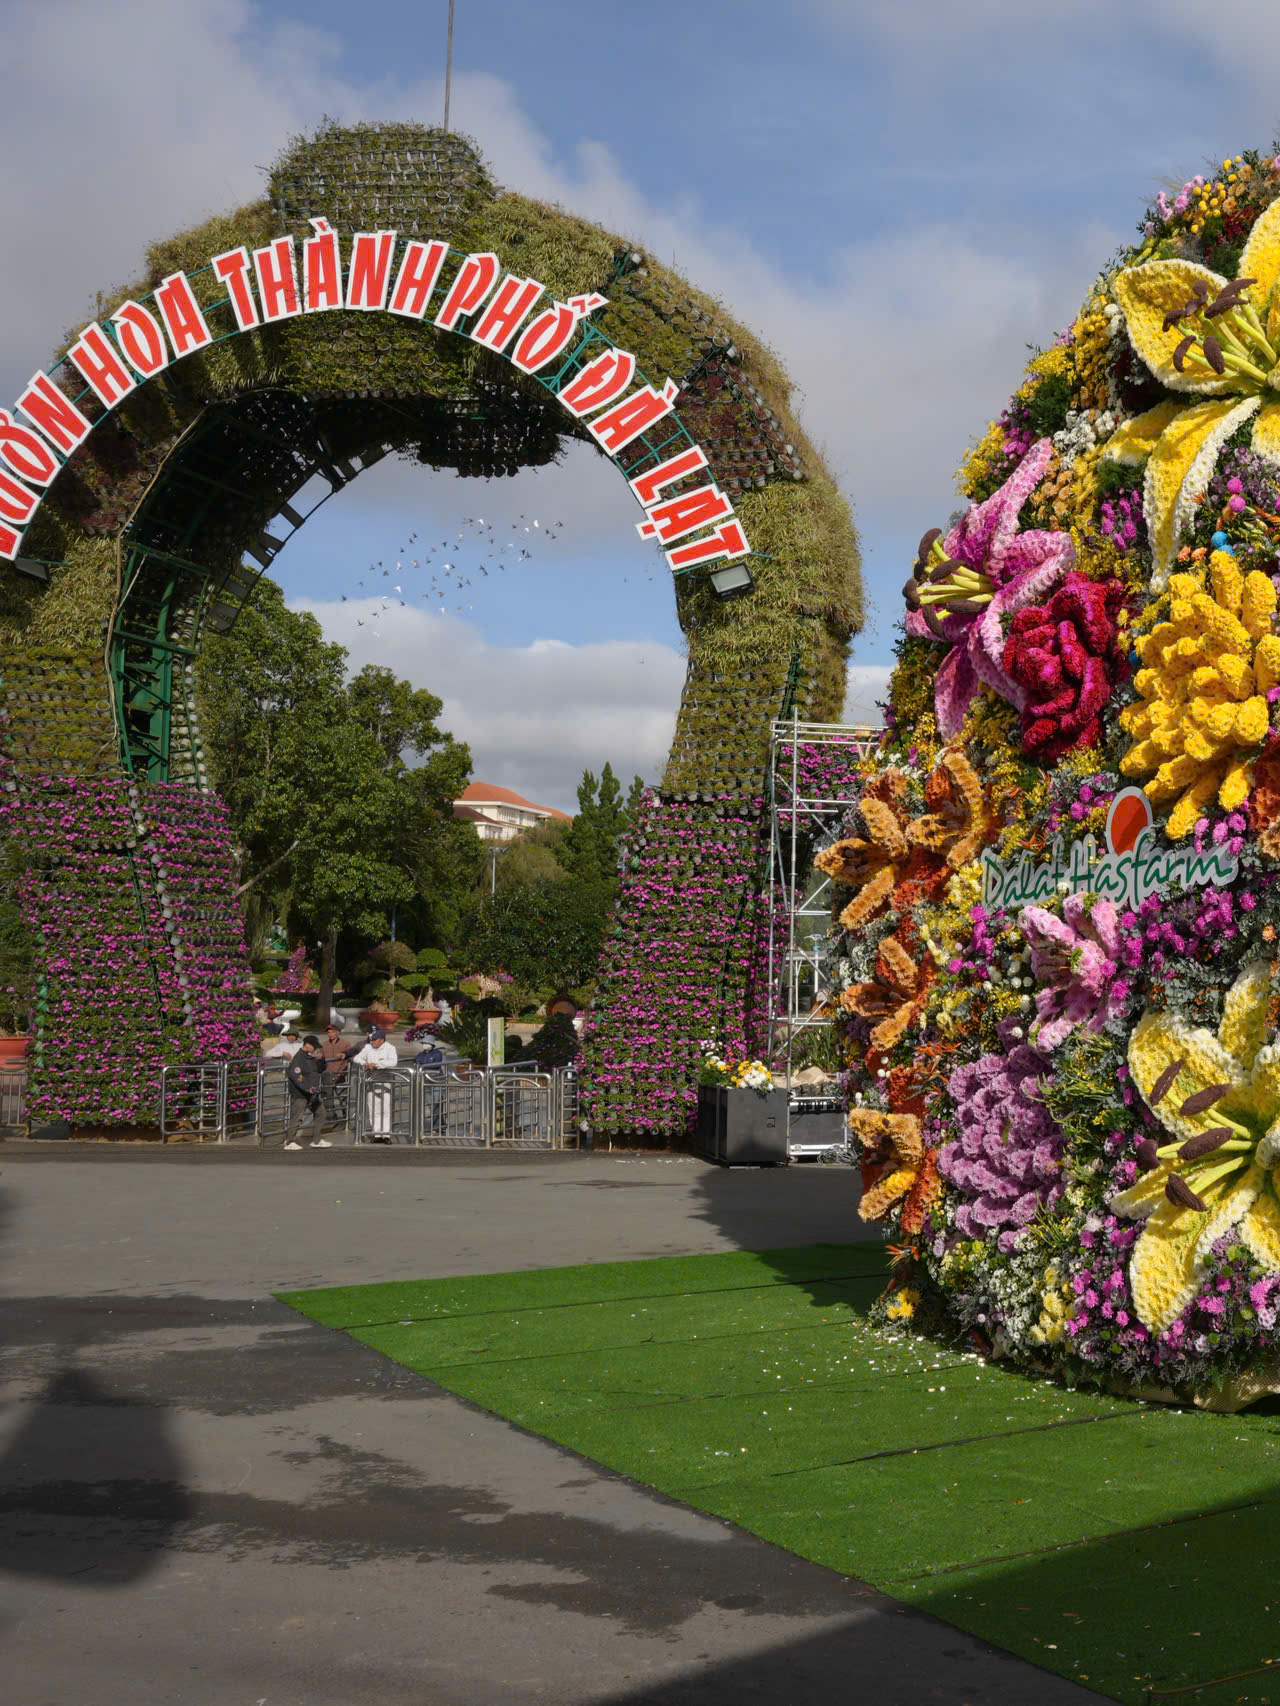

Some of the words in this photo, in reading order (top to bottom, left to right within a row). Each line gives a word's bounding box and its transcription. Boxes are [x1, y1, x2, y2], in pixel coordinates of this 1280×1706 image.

[67, 271, 213, 410] HOA
[211, 217, 449, 329] THÀNH
[434, 252, 609, 375] PHỐ
[635, 444, 752, 571] LẠT
[983, 842, 1065, 906] Dalat
[1069, 832, 1233, 906] Hasfarm
